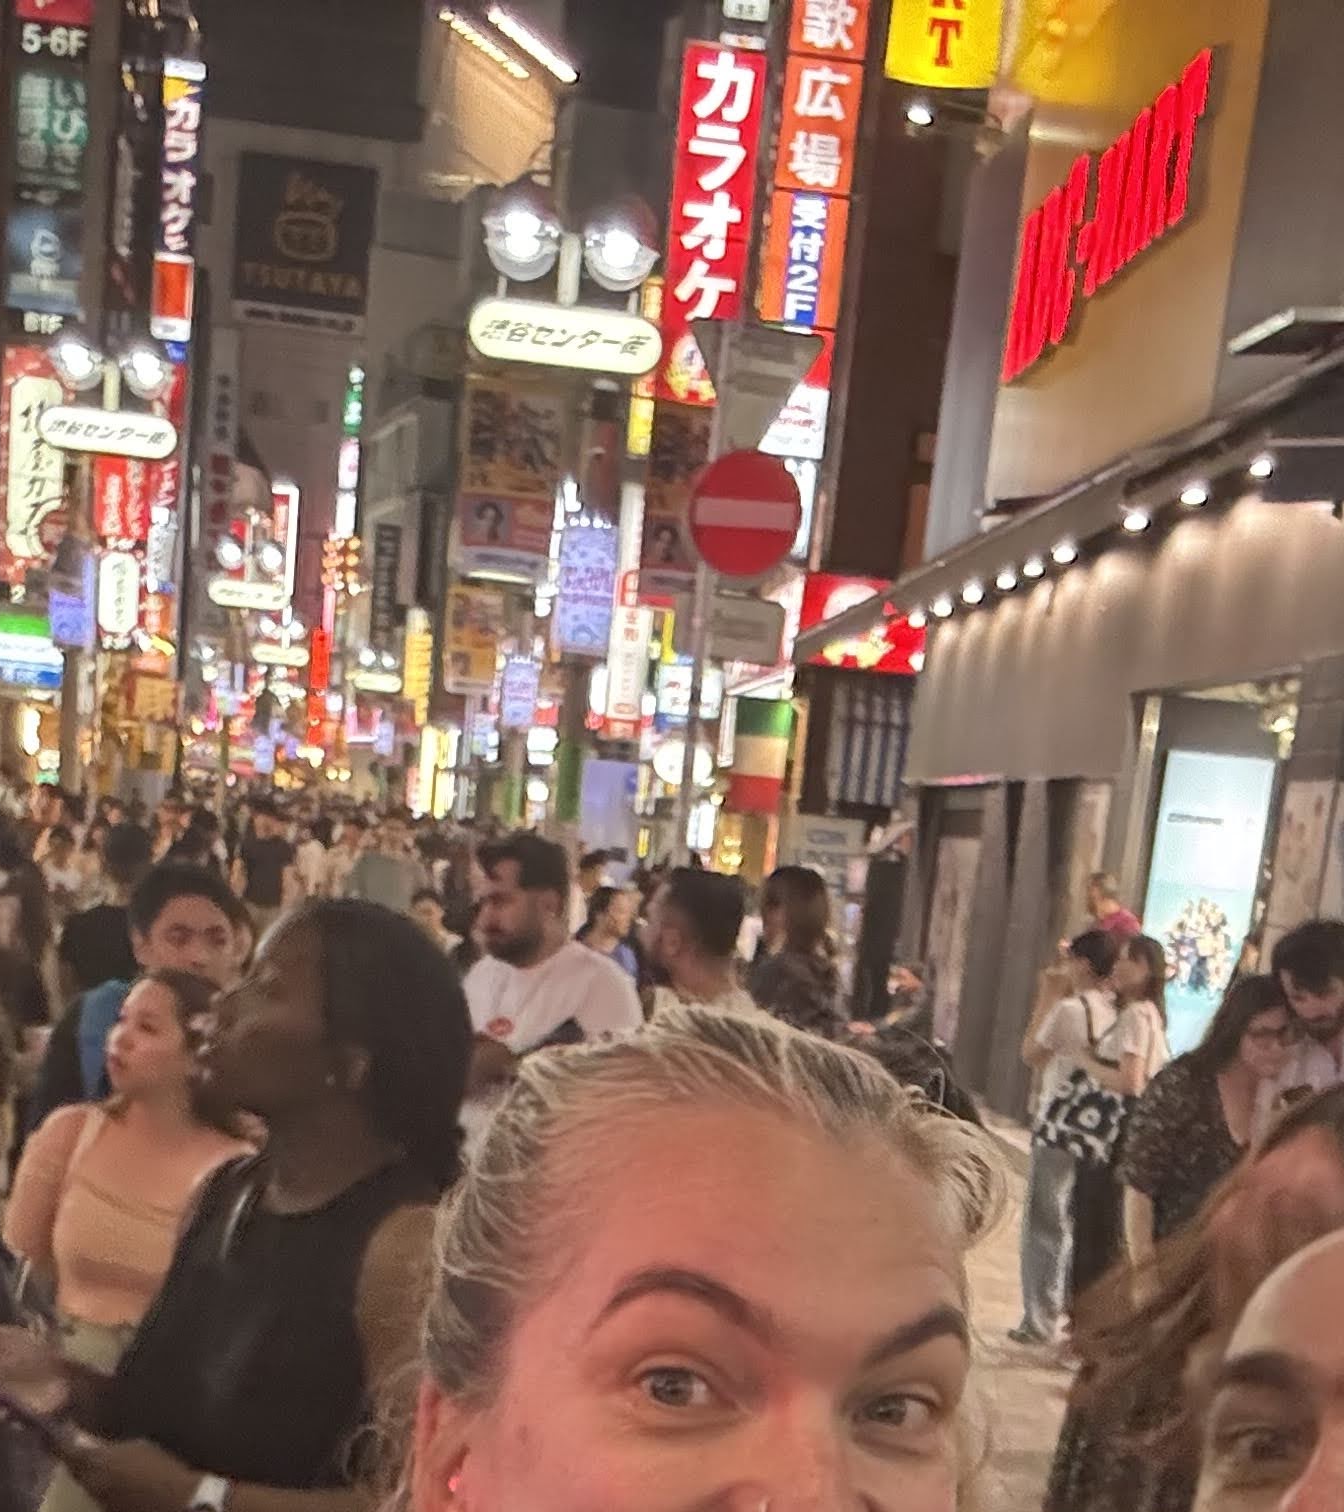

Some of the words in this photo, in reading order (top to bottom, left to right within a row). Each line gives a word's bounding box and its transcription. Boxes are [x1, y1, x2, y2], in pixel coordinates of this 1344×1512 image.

[927, 0, 967, 68] T
[673, 51, 756, 322] カラオケ
[783, 199, 828, 322] 受付2F
